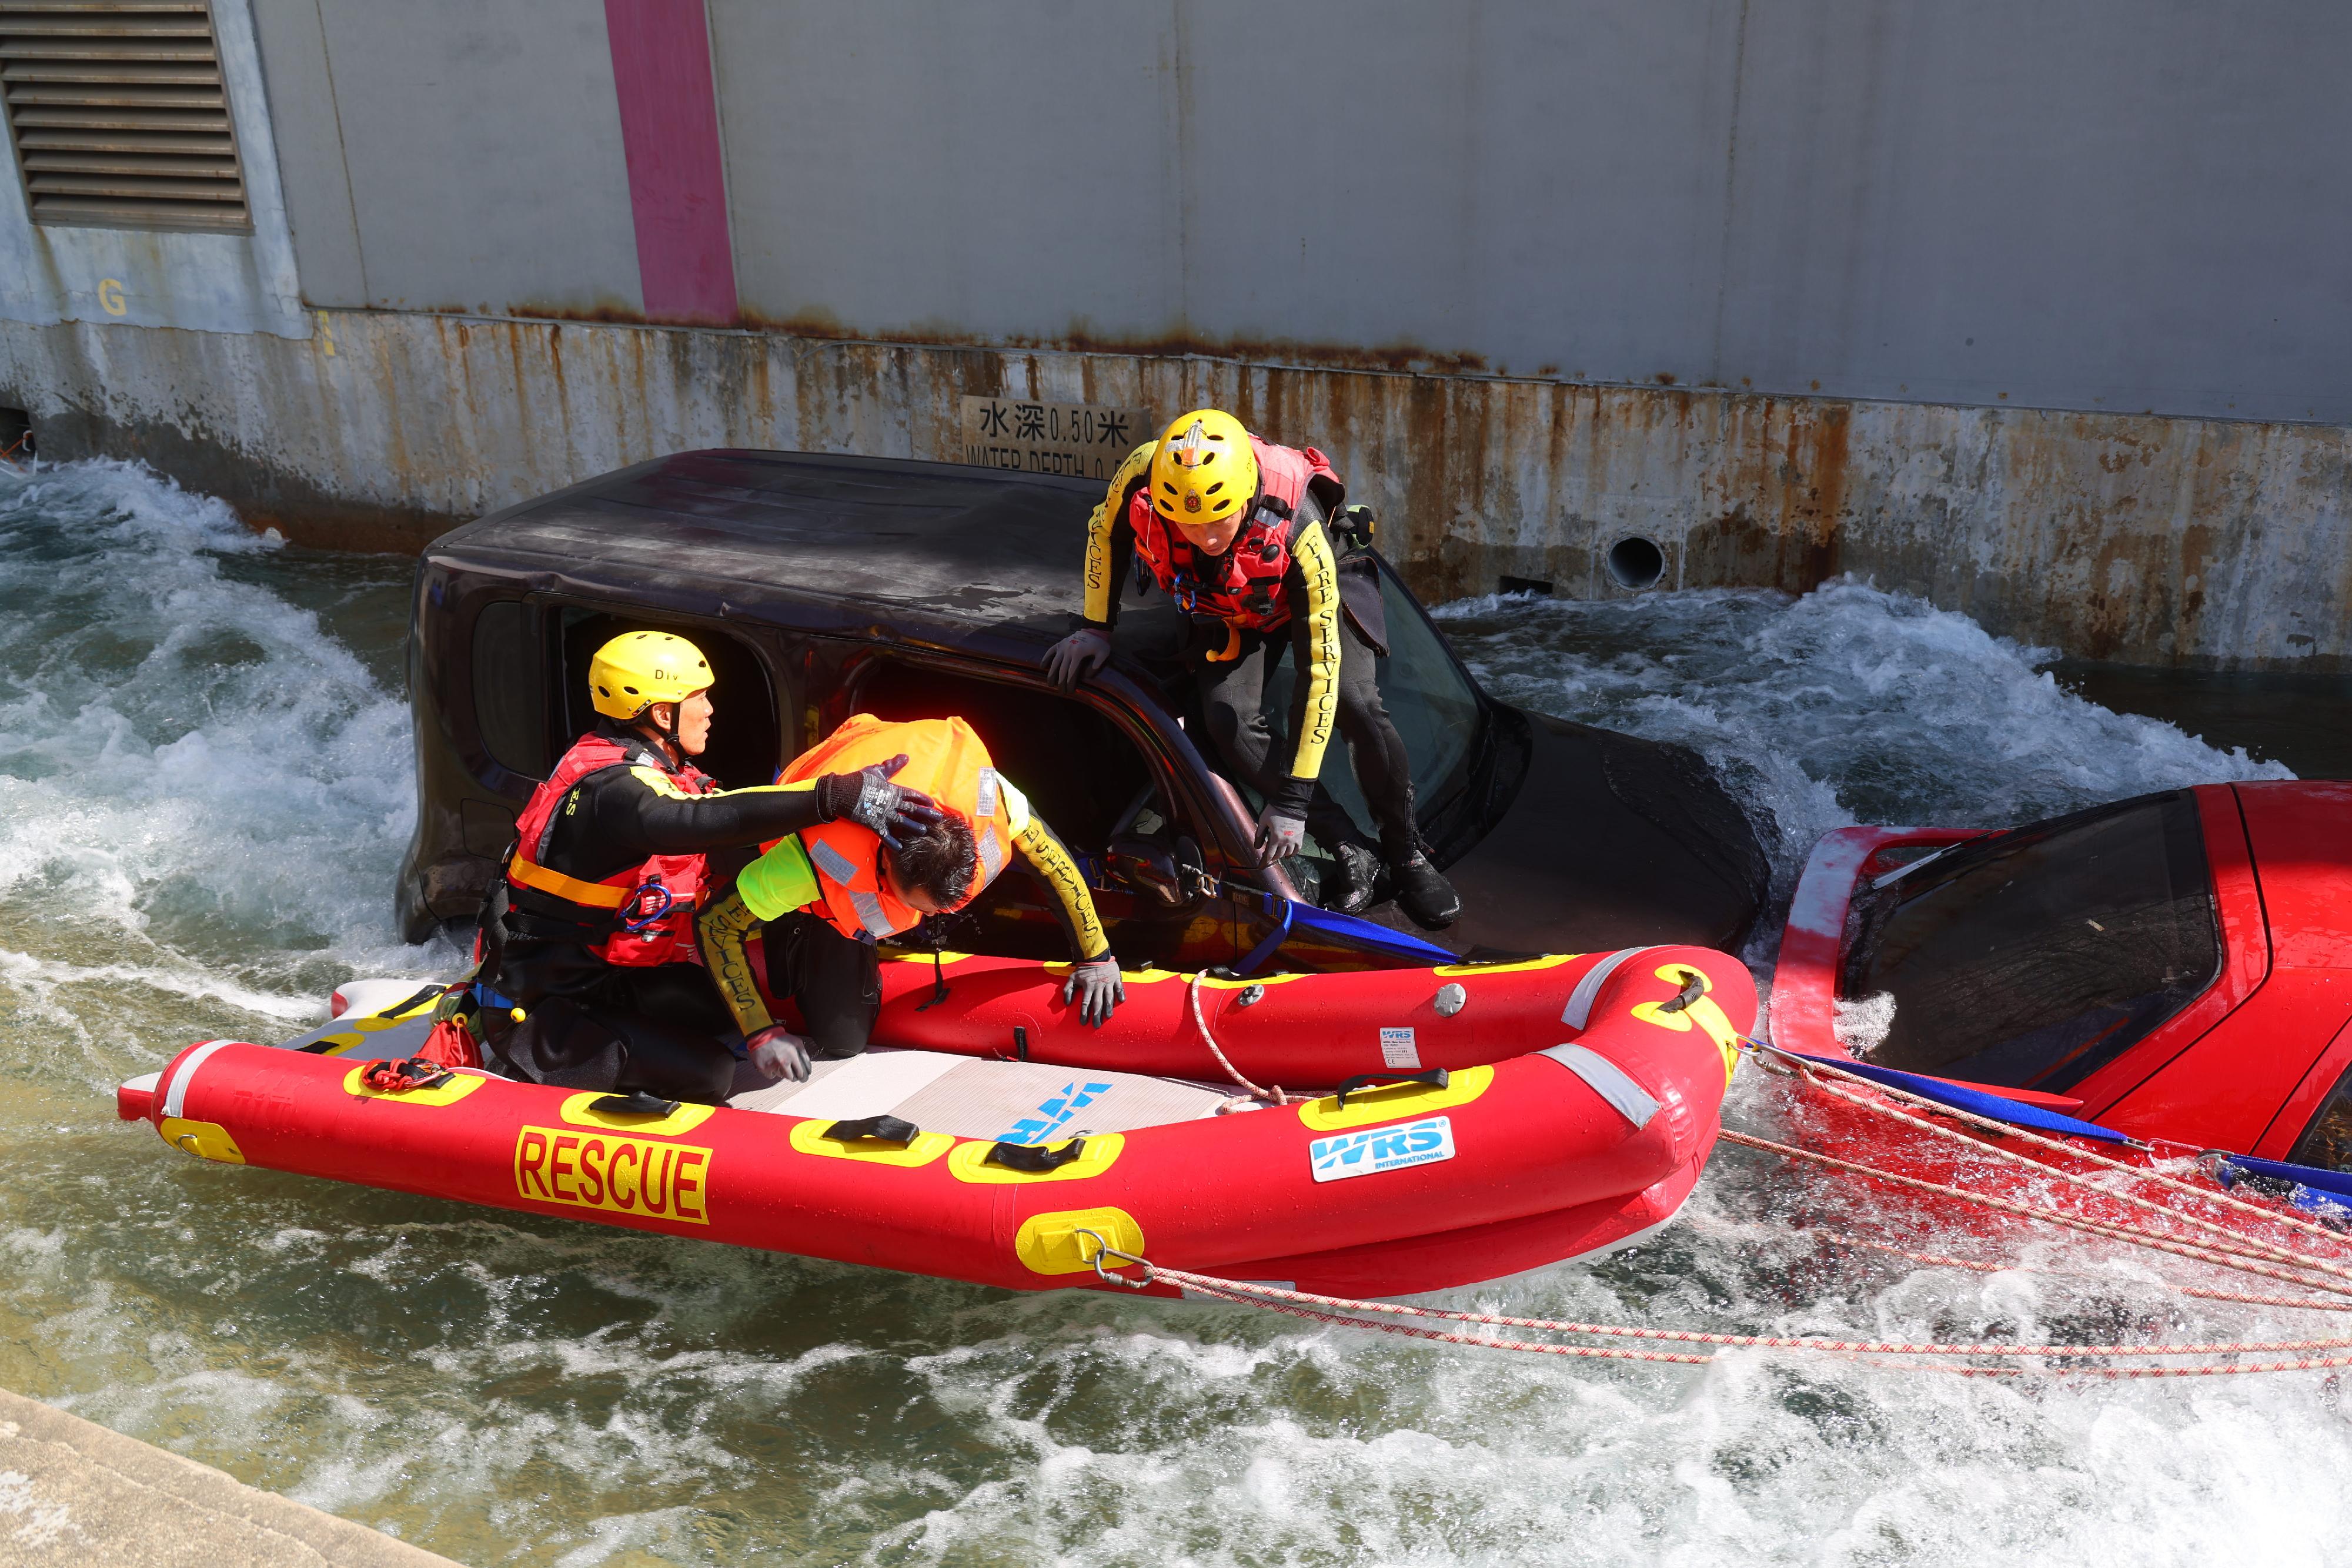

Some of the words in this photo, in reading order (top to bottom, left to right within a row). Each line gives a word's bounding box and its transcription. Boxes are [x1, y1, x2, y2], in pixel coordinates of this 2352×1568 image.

[98, 278, 128, 316] G
[980, 401, 1129, 448] 水深0.50米
[1306, 535, 1333, 606] FIRE
[1311, 609, 1338, 744] SERVICES
[1035, 840, 1098, 939] SERVICES
[519, 1132, 704, 1219] RESCUE
[1375, 1151, 1445, 1170] INTERNATIONAL
